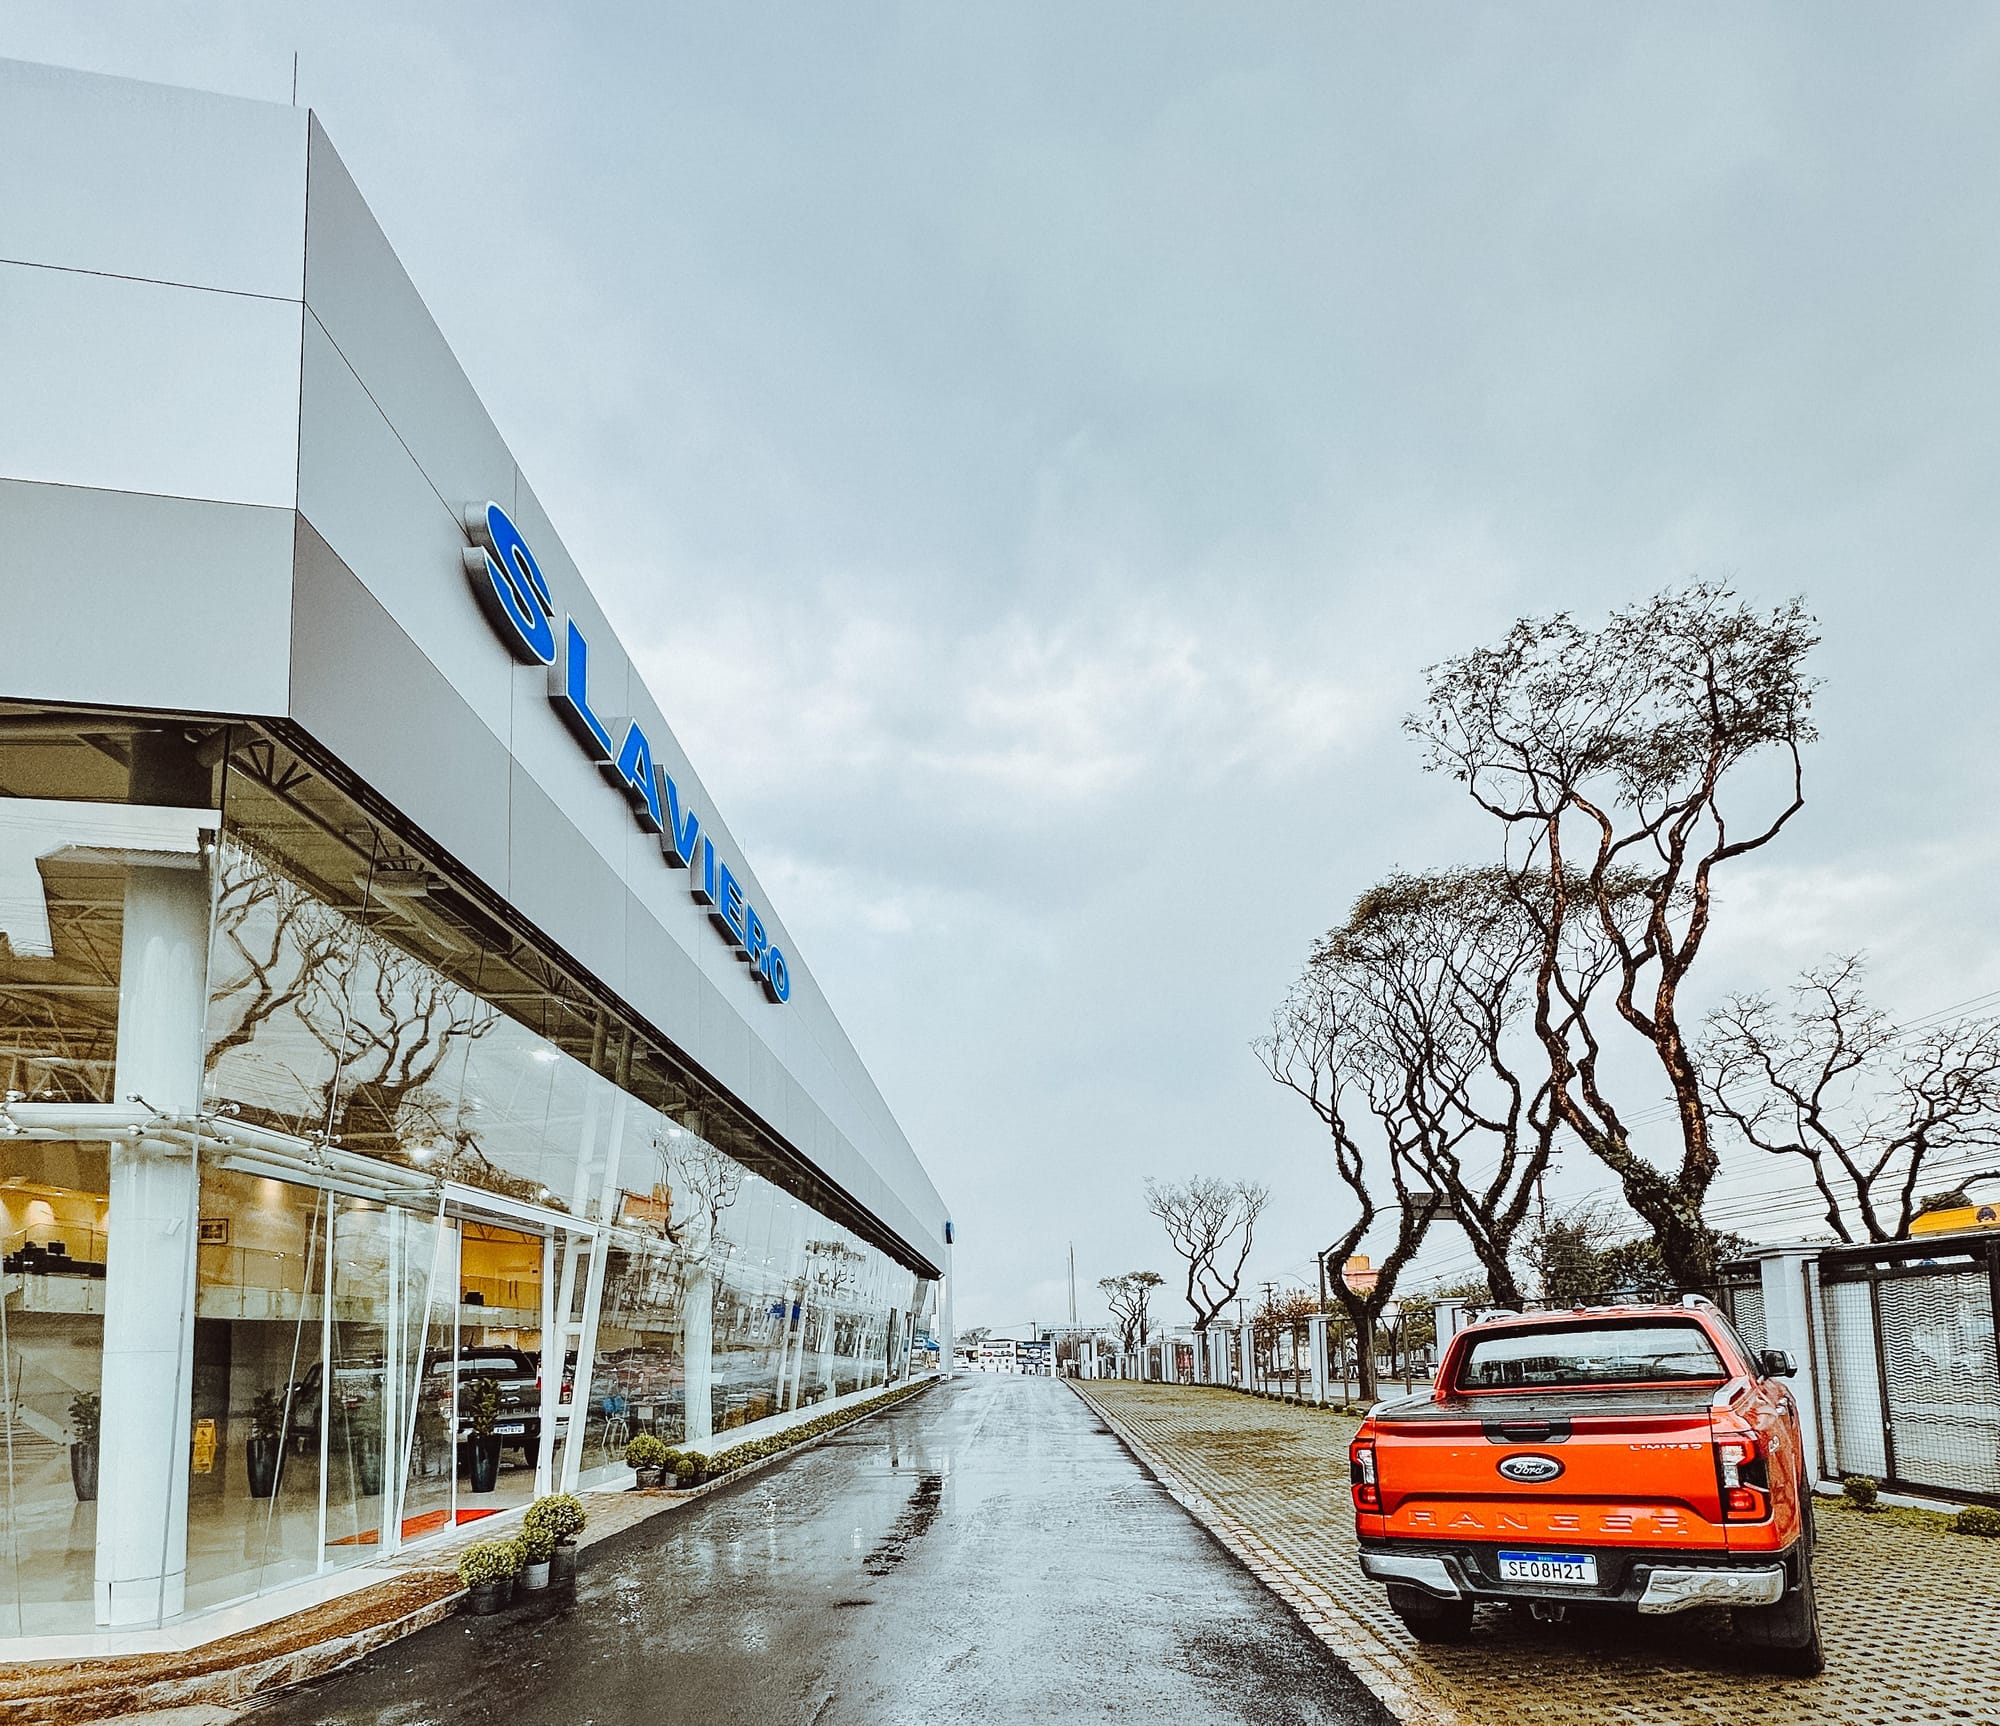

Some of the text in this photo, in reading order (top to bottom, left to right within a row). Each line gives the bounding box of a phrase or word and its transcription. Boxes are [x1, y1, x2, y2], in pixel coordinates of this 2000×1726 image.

[482, 500, 790, 1004] SLAVIERO
[1629, 1443, 1704, 1451] LIMITED
[1513, 1461, 1545, 1475] Ford
[1408, 1509, 1688, 1535] RANGER
